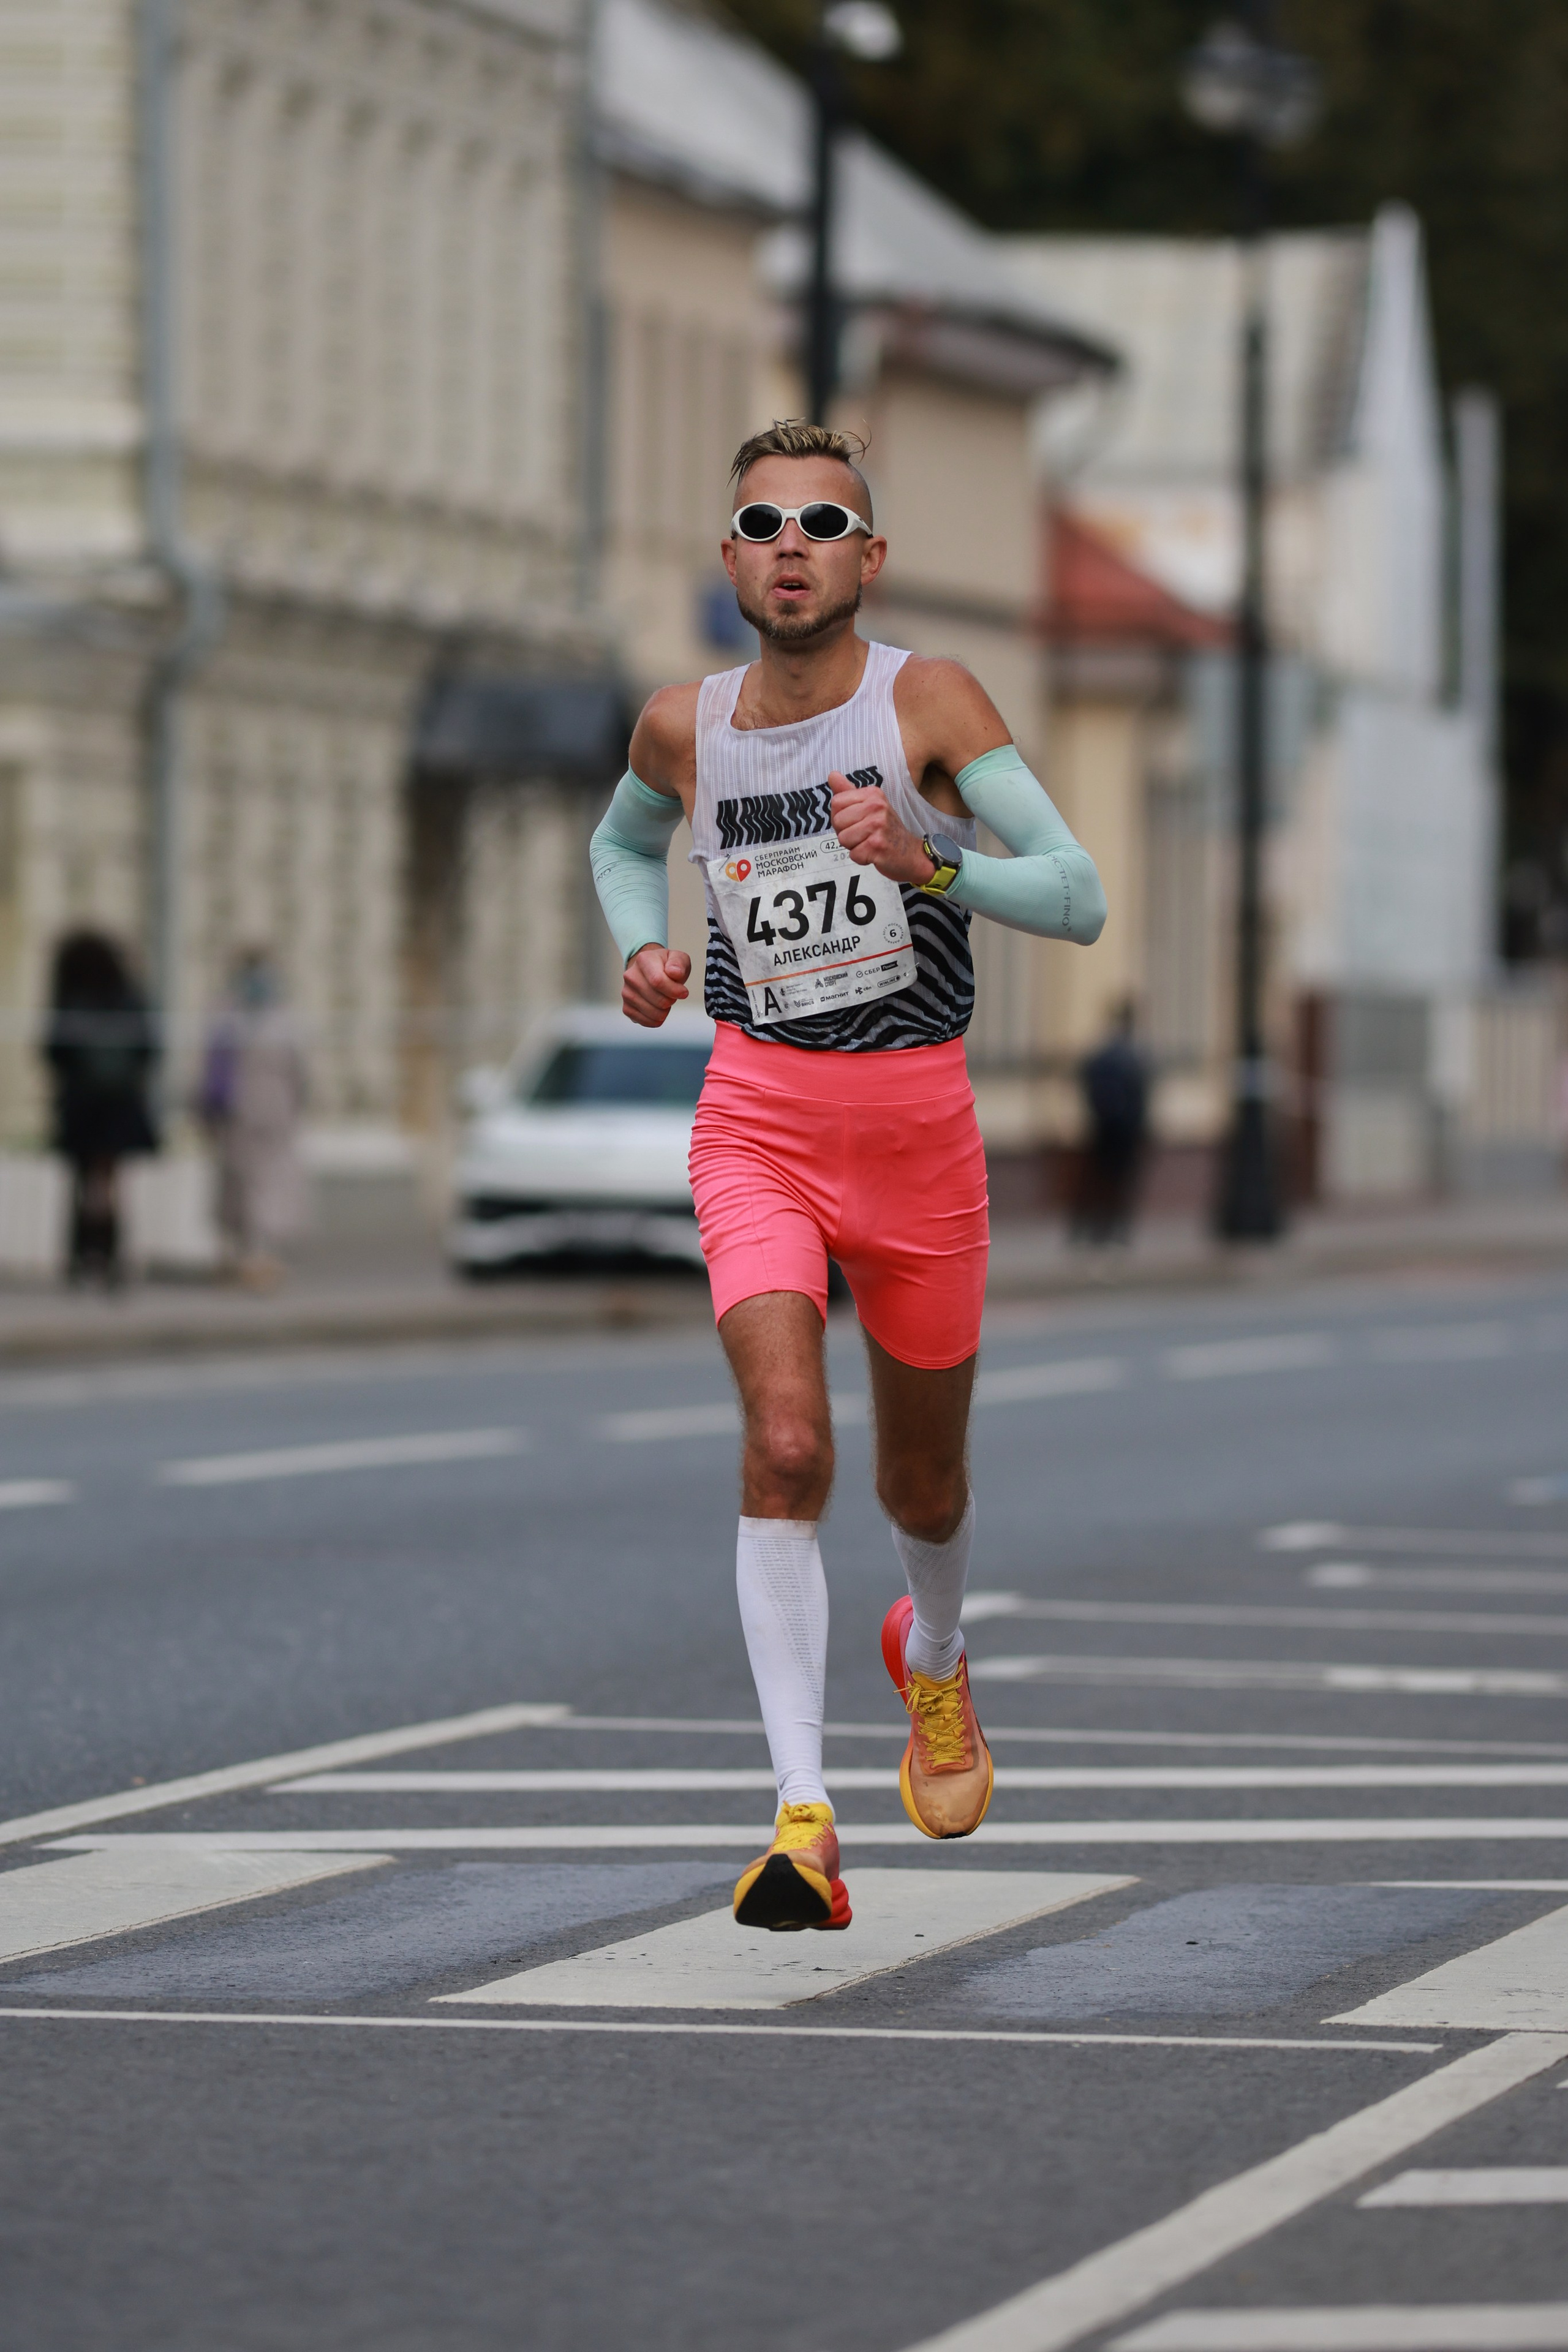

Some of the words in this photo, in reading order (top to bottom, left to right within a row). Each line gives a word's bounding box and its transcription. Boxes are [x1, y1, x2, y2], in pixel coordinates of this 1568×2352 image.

[755, 846, 801, 861] СБЕРПРАЙМ
[825, 841, 843, 850] 42,
[756, 850, 818, 870] МОСКОВСКИЙ
[758, 862, 804, 878] МАРАФОН
[747, 875, 876, 946] 4376
[889, 929, 897, 938] 6
[774, 936, 861, 966] АЛЕКСАНДР
[764, 986, 782, 1016] A
